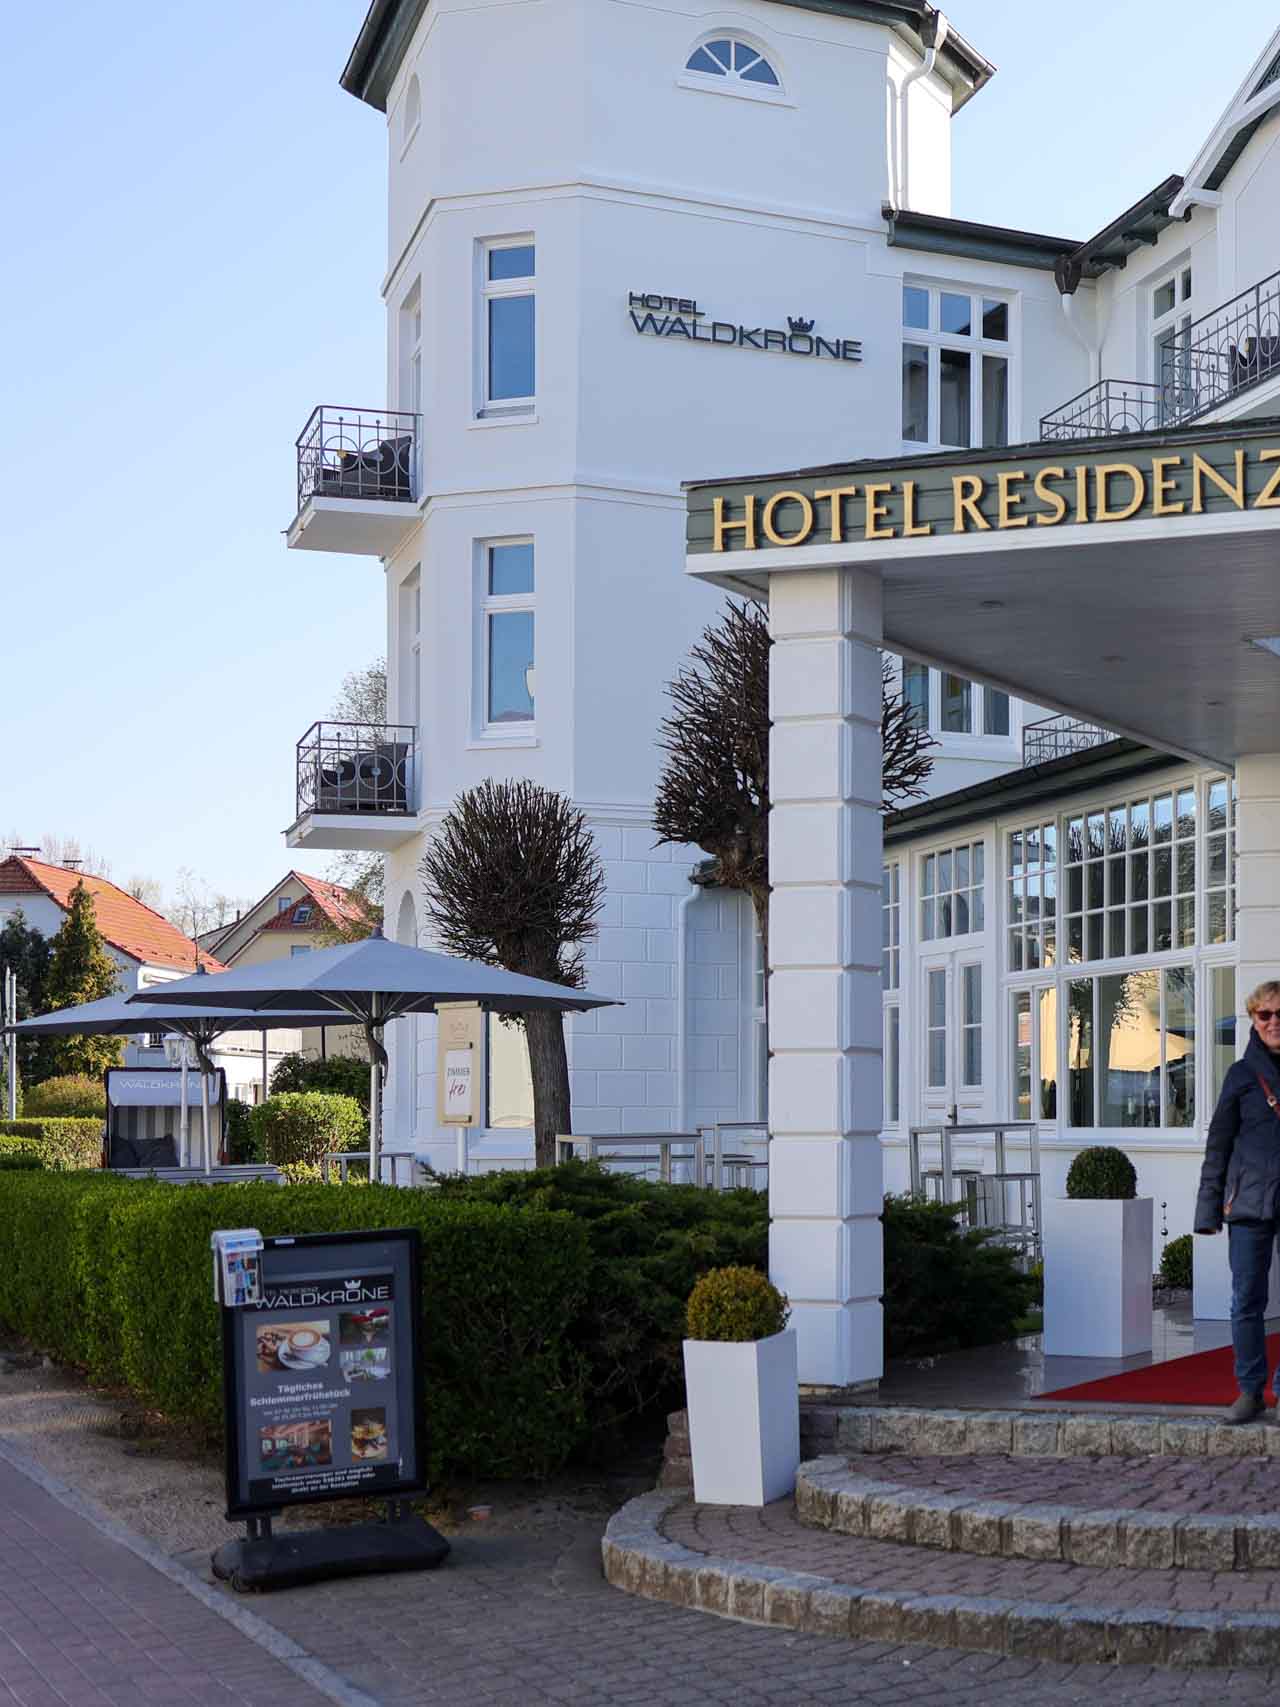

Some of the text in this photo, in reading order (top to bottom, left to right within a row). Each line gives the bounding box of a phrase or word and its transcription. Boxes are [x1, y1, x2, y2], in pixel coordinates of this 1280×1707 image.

[627, 291, 706, 316] HOTEL
[628, 309, 863, 362] WALDKRONE
[711, 479, 931, 552] HOTEL
[254, 1286, 390, 1309] WALDKRONE
